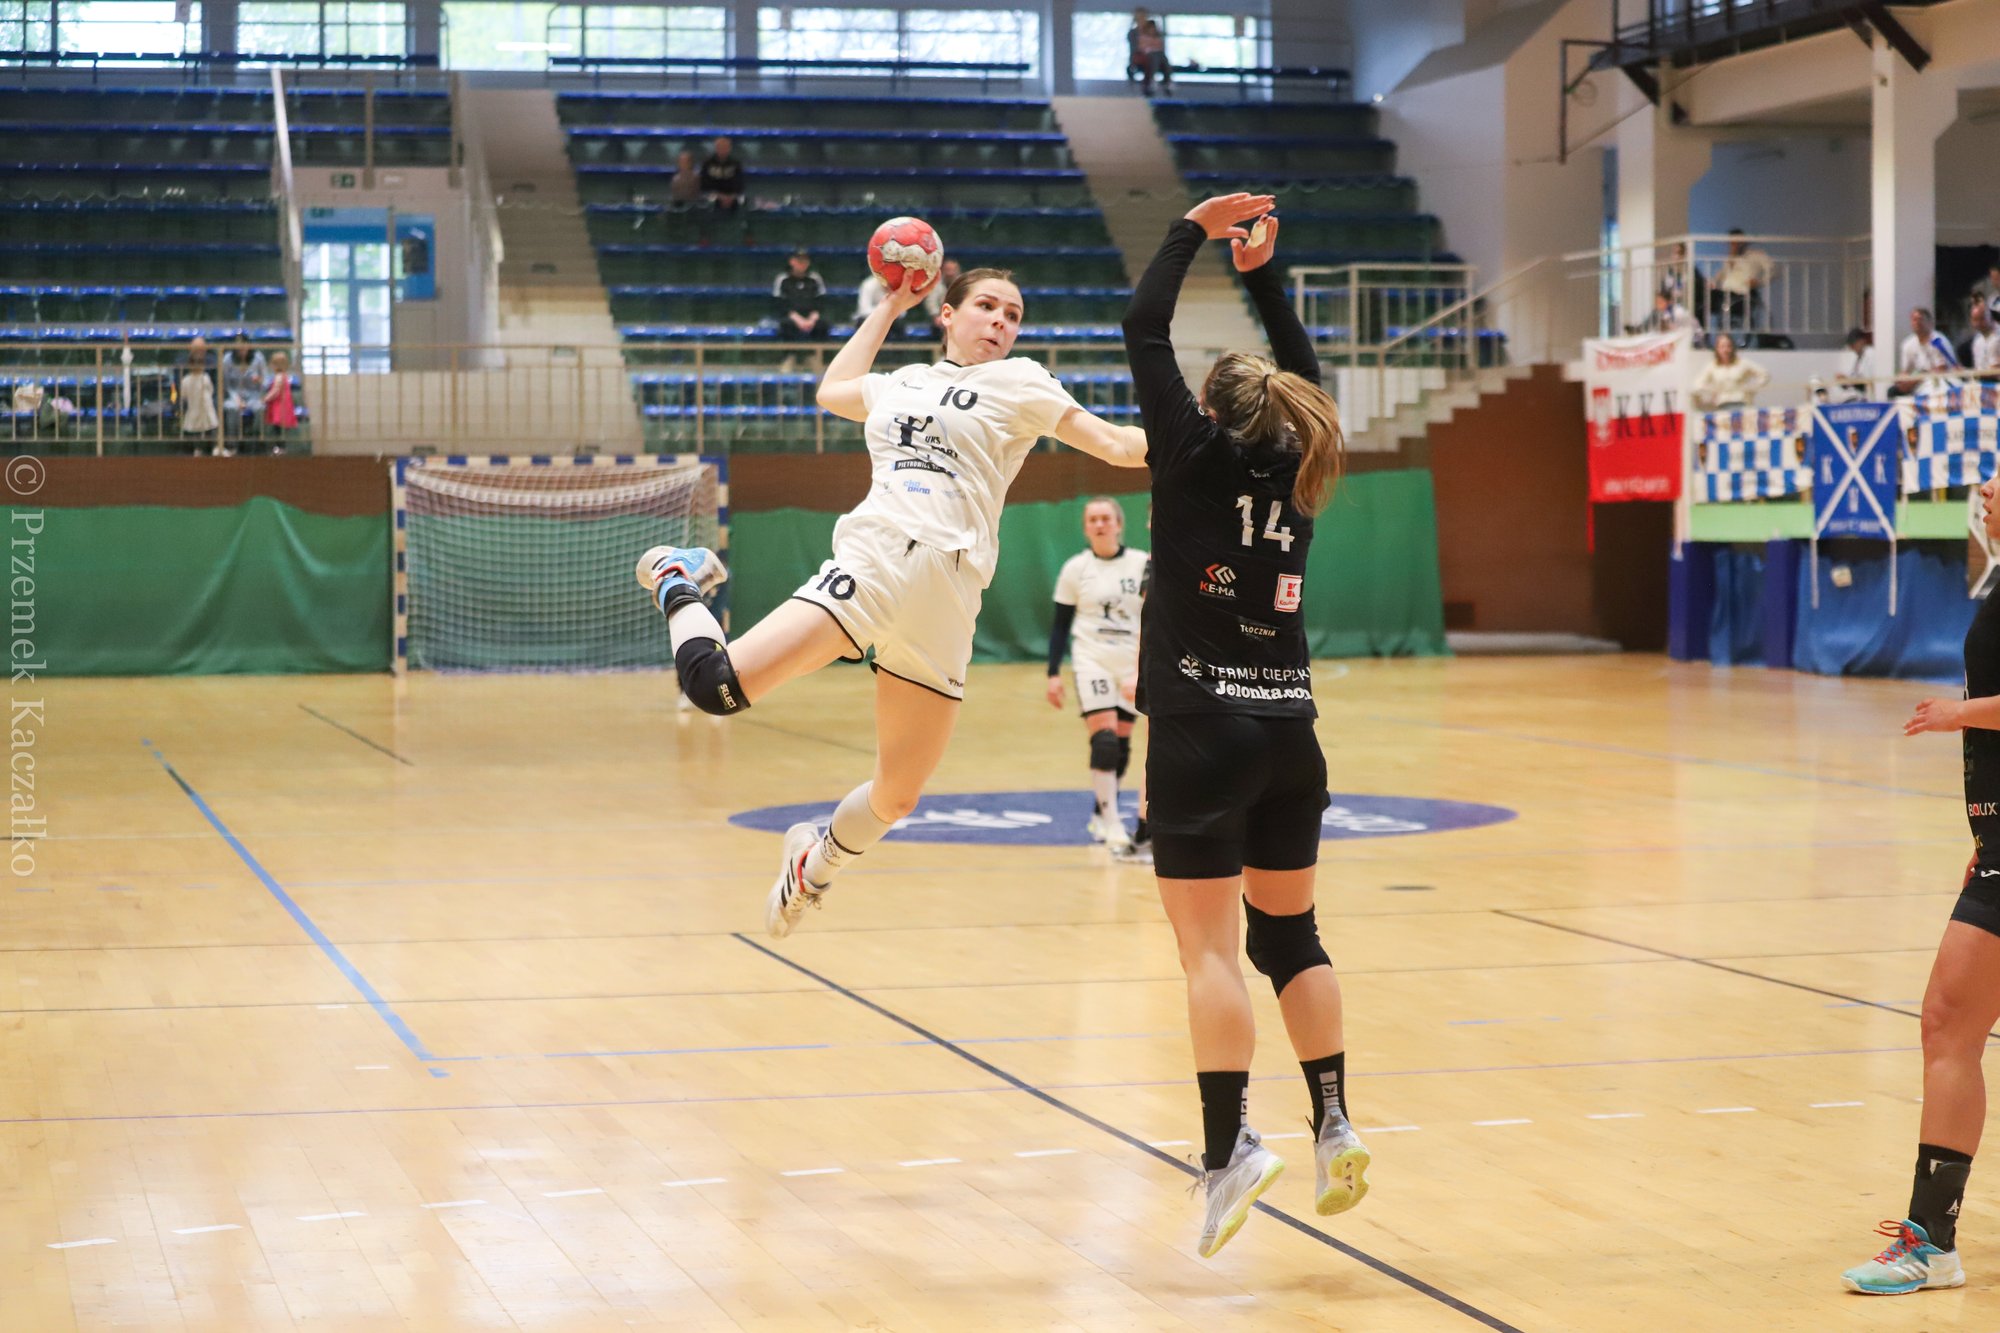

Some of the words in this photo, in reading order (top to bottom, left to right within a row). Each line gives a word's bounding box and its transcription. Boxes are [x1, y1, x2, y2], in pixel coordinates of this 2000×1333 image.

[940, 386, 978, 410] 10
[925, 435, 941, 444] UKS
[1236, 495, 1295, 552] 14
[816, 567, 856, 600] 10
[1120, 578, 1137, 594] 13
[1200, 581, 1237, 598] KE-MA
[1240, 624, 1276, 637] TŁOCZNIA
[1208, 664, 1258, 681] TERMY
[1091, 679, 1110, 695] 13
[720, 683, 737, 709] SELECT
[1968, 802, 1997, 816] BOLIX
